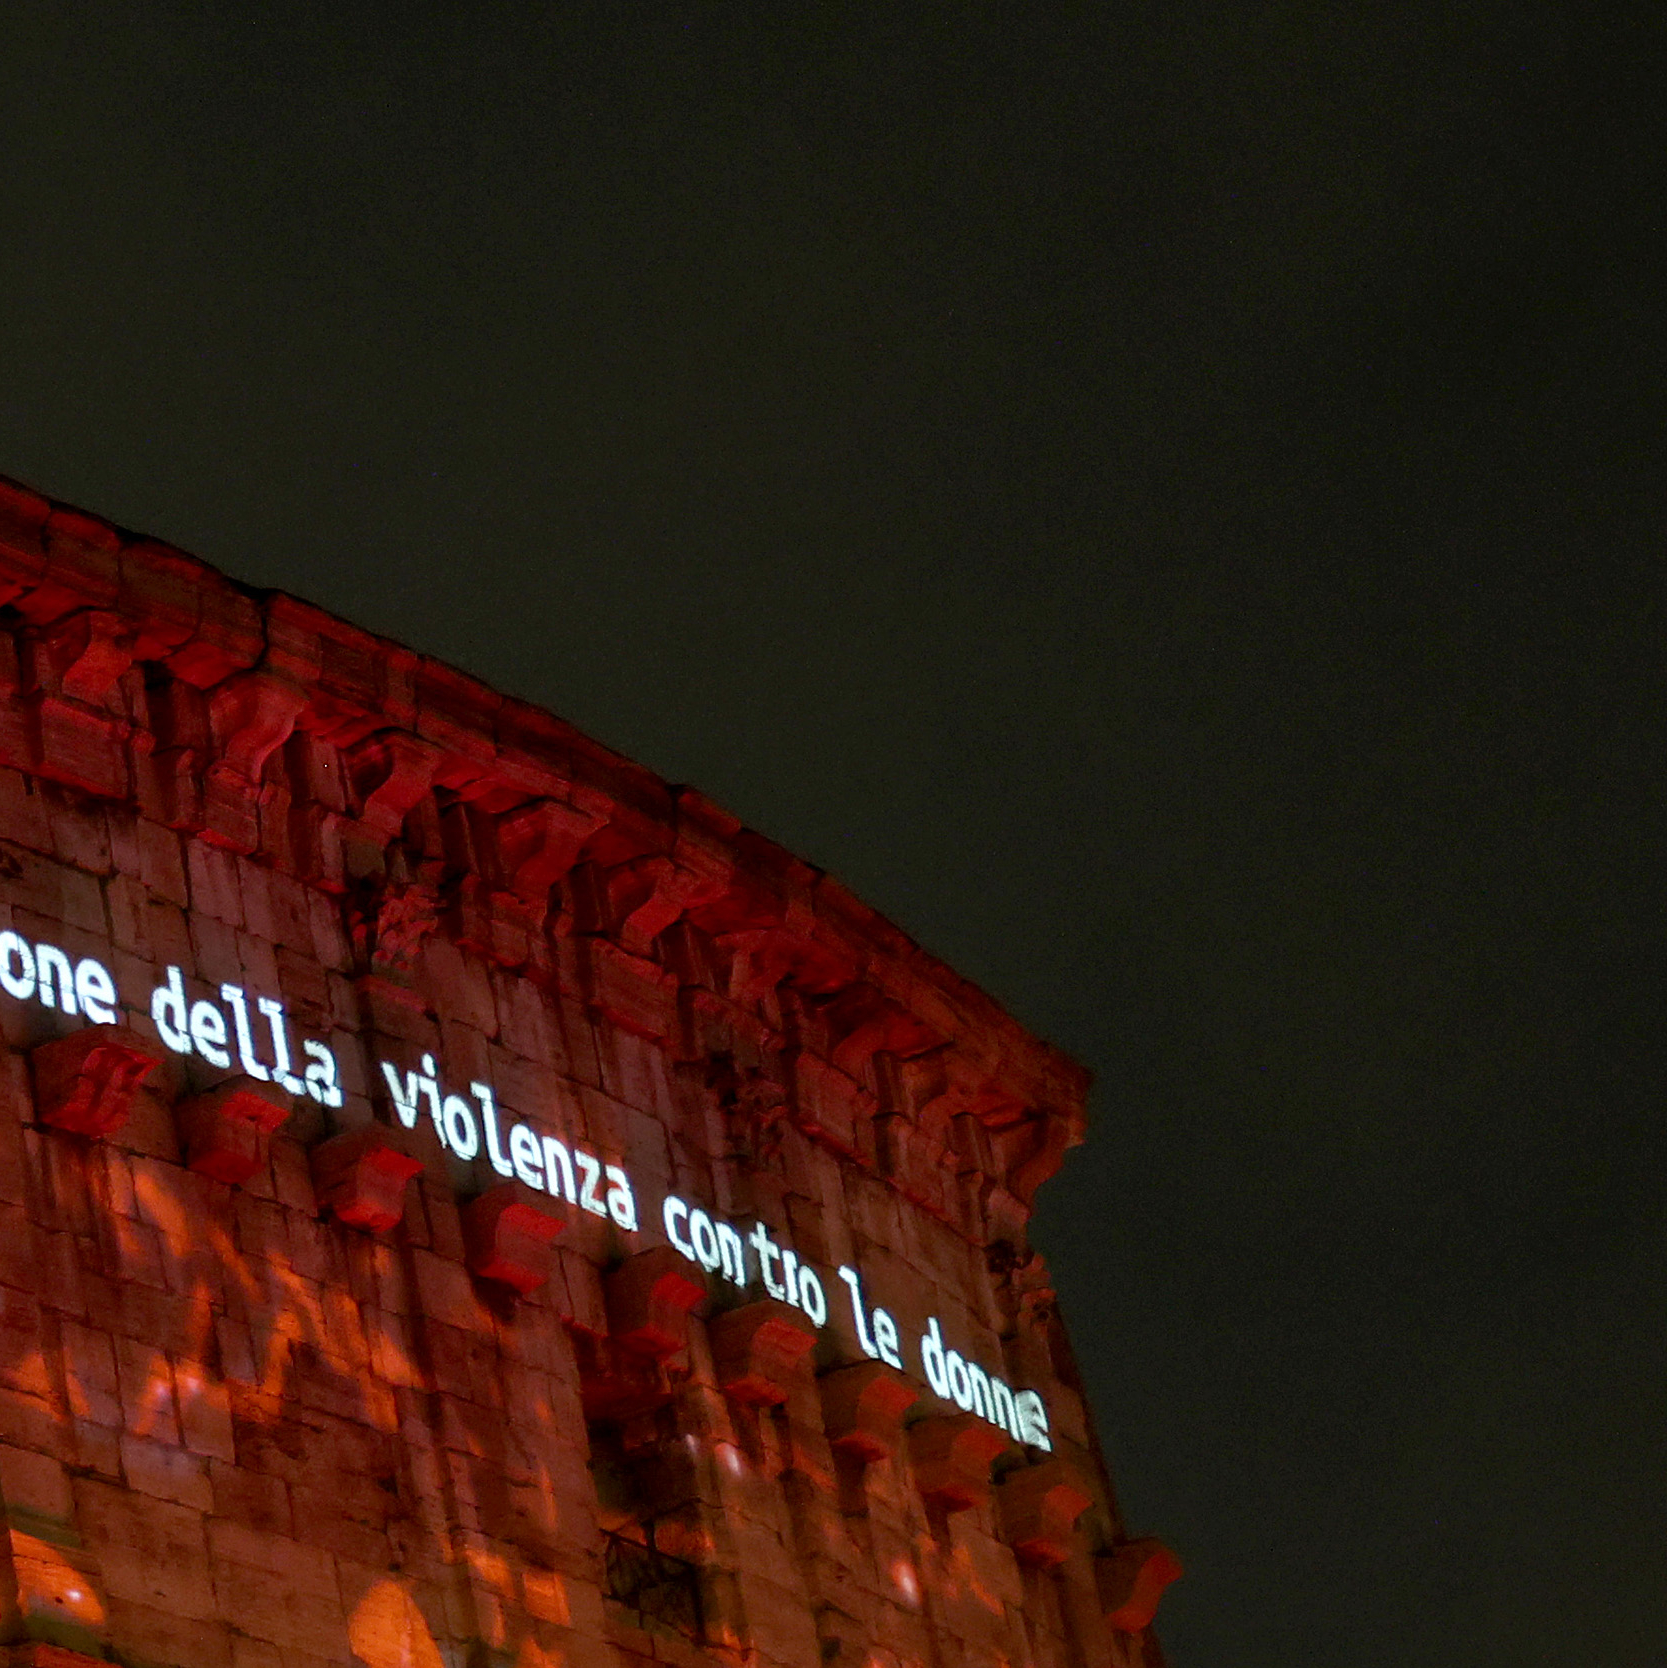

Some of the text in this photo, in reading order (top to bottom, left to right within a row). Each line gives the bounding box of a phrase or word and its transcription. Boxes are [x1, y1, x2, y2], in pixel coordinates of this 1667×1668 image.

[150, 963, 344, 1108] della
[380, 1053, 639, 1232] violenza
[662, 1194, 828, 1329] contro
[837, 1264, 903, 1370] le
[921, 1316, 1052, 1452] donne
